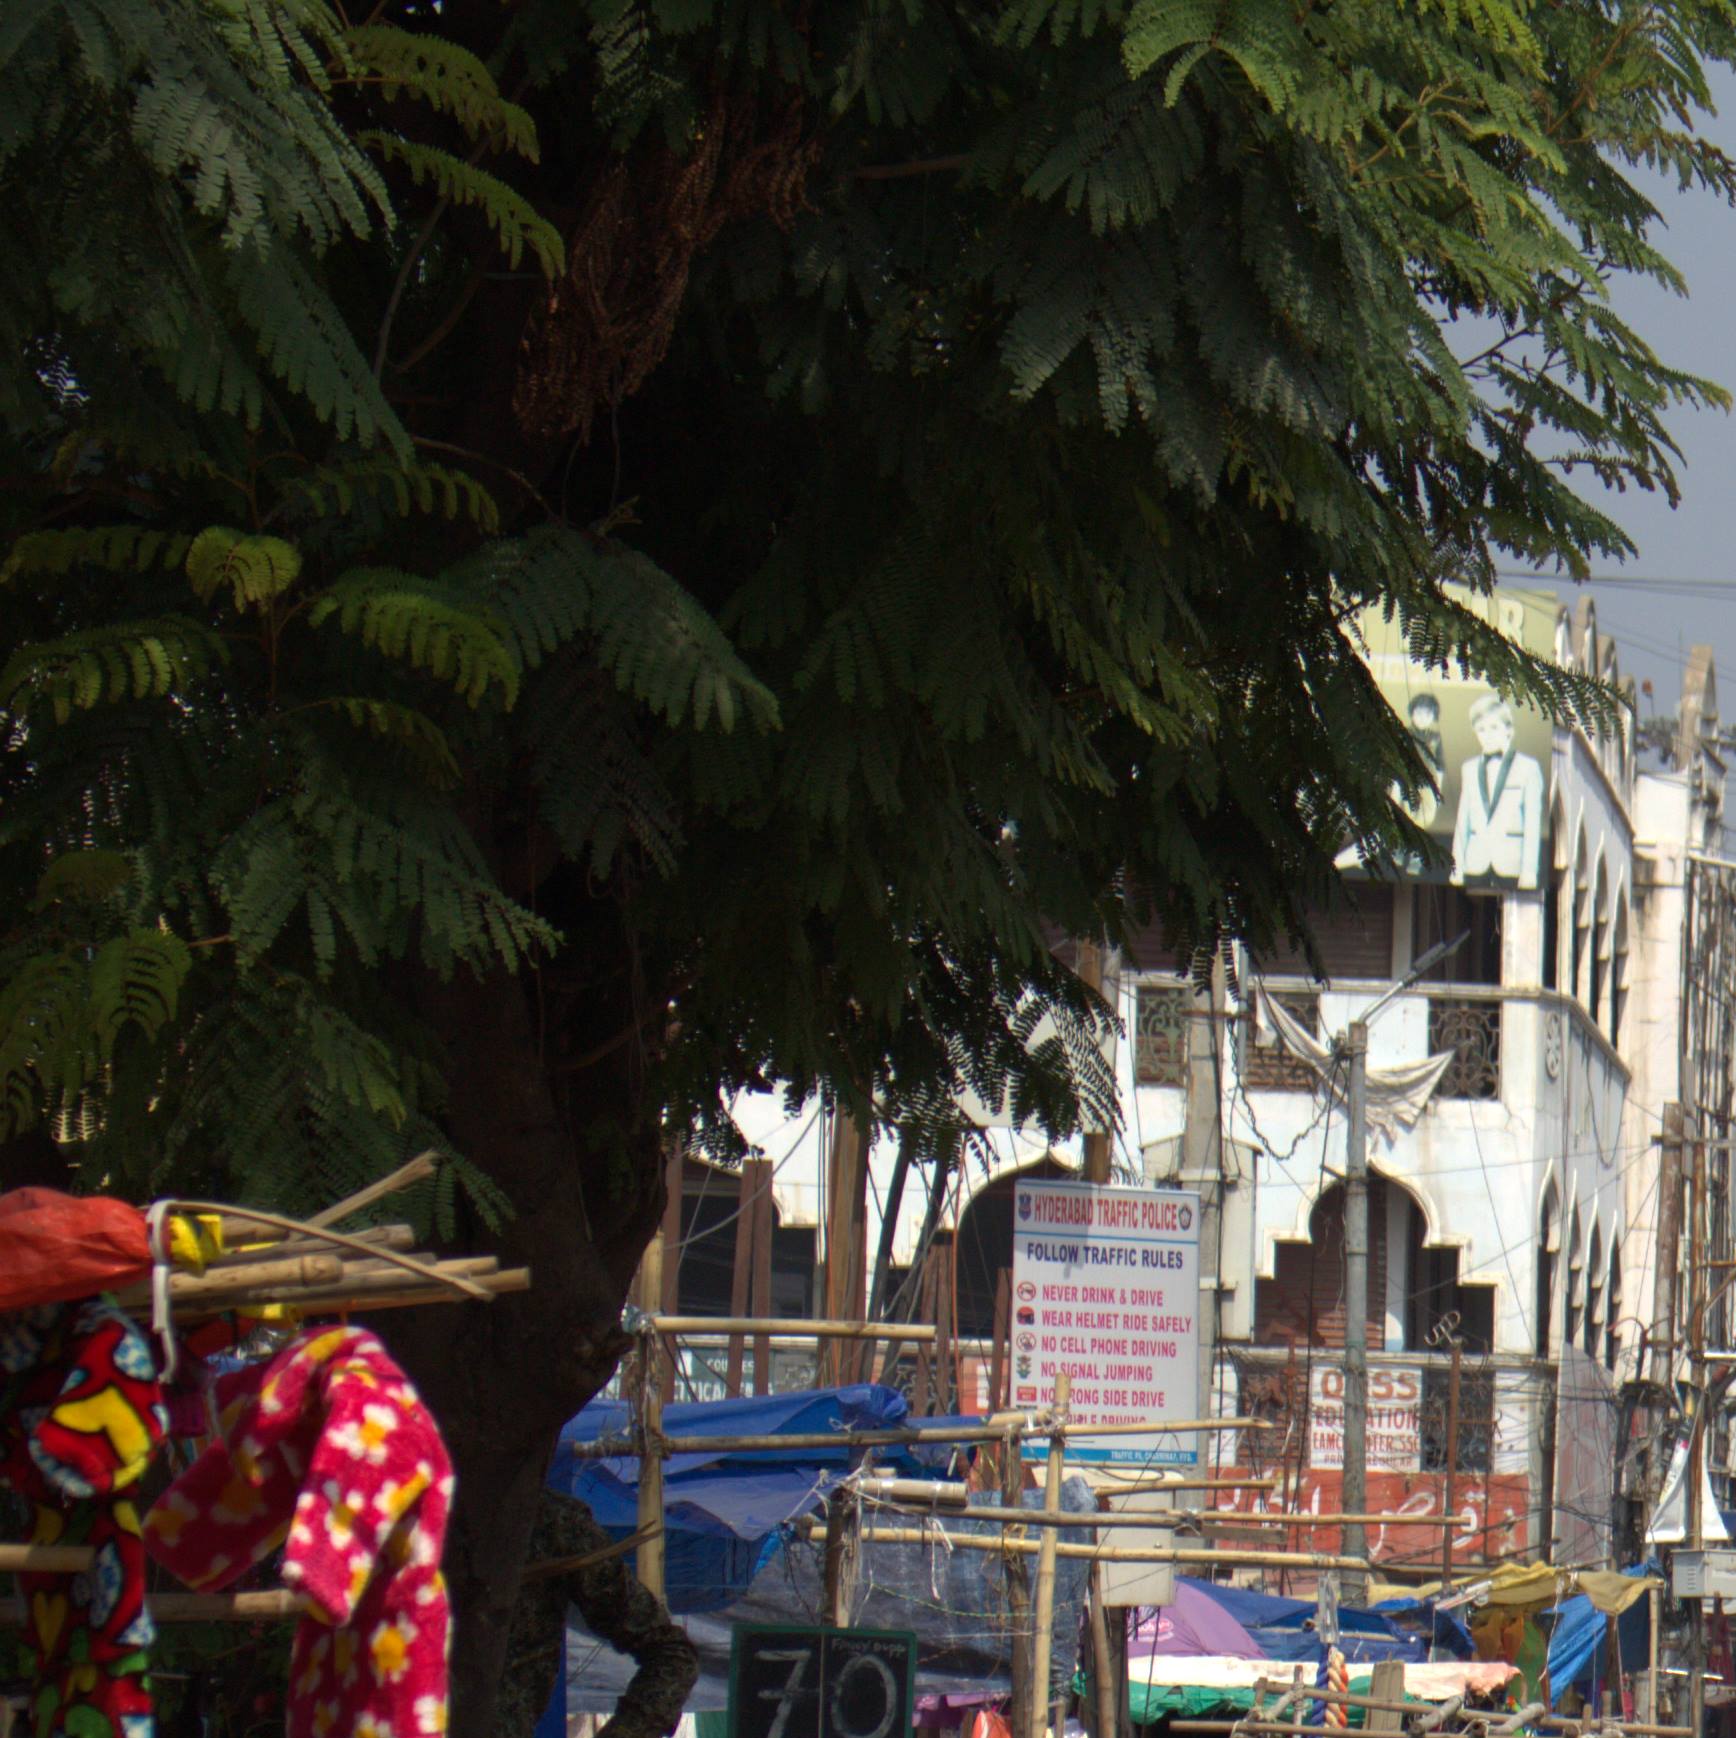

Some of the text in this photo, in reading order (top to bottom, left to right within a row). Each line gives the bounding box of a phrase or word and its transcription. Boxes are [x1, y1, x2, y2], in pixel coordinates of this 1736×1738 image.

[1034, 1193, 1178, 1231] HYDERABAD TRAFFIC POLICE
[1027, 1242, 1183, 1269] FOLLOW TRAFFIC RULES
[1042, 1284, 1163, 1306] NEVER DRINK & DRIVE
[1042, 1310, 1192, 1333] WEAR HELMET RIDE SAFELY
[1041, 1336, 1177, 1358] NO CELL PHONE DRIVING
[1041, 1361, 1153, 1382] NO SIGNAL JUMPING
[1040, 1388, 1056, 1404] NO
[1069, 1389, 1099, 1406] RONG
[1102, 1389, 1128, 1406] SIDE
[1131, 1391, 1165, 1408] DRIVE
